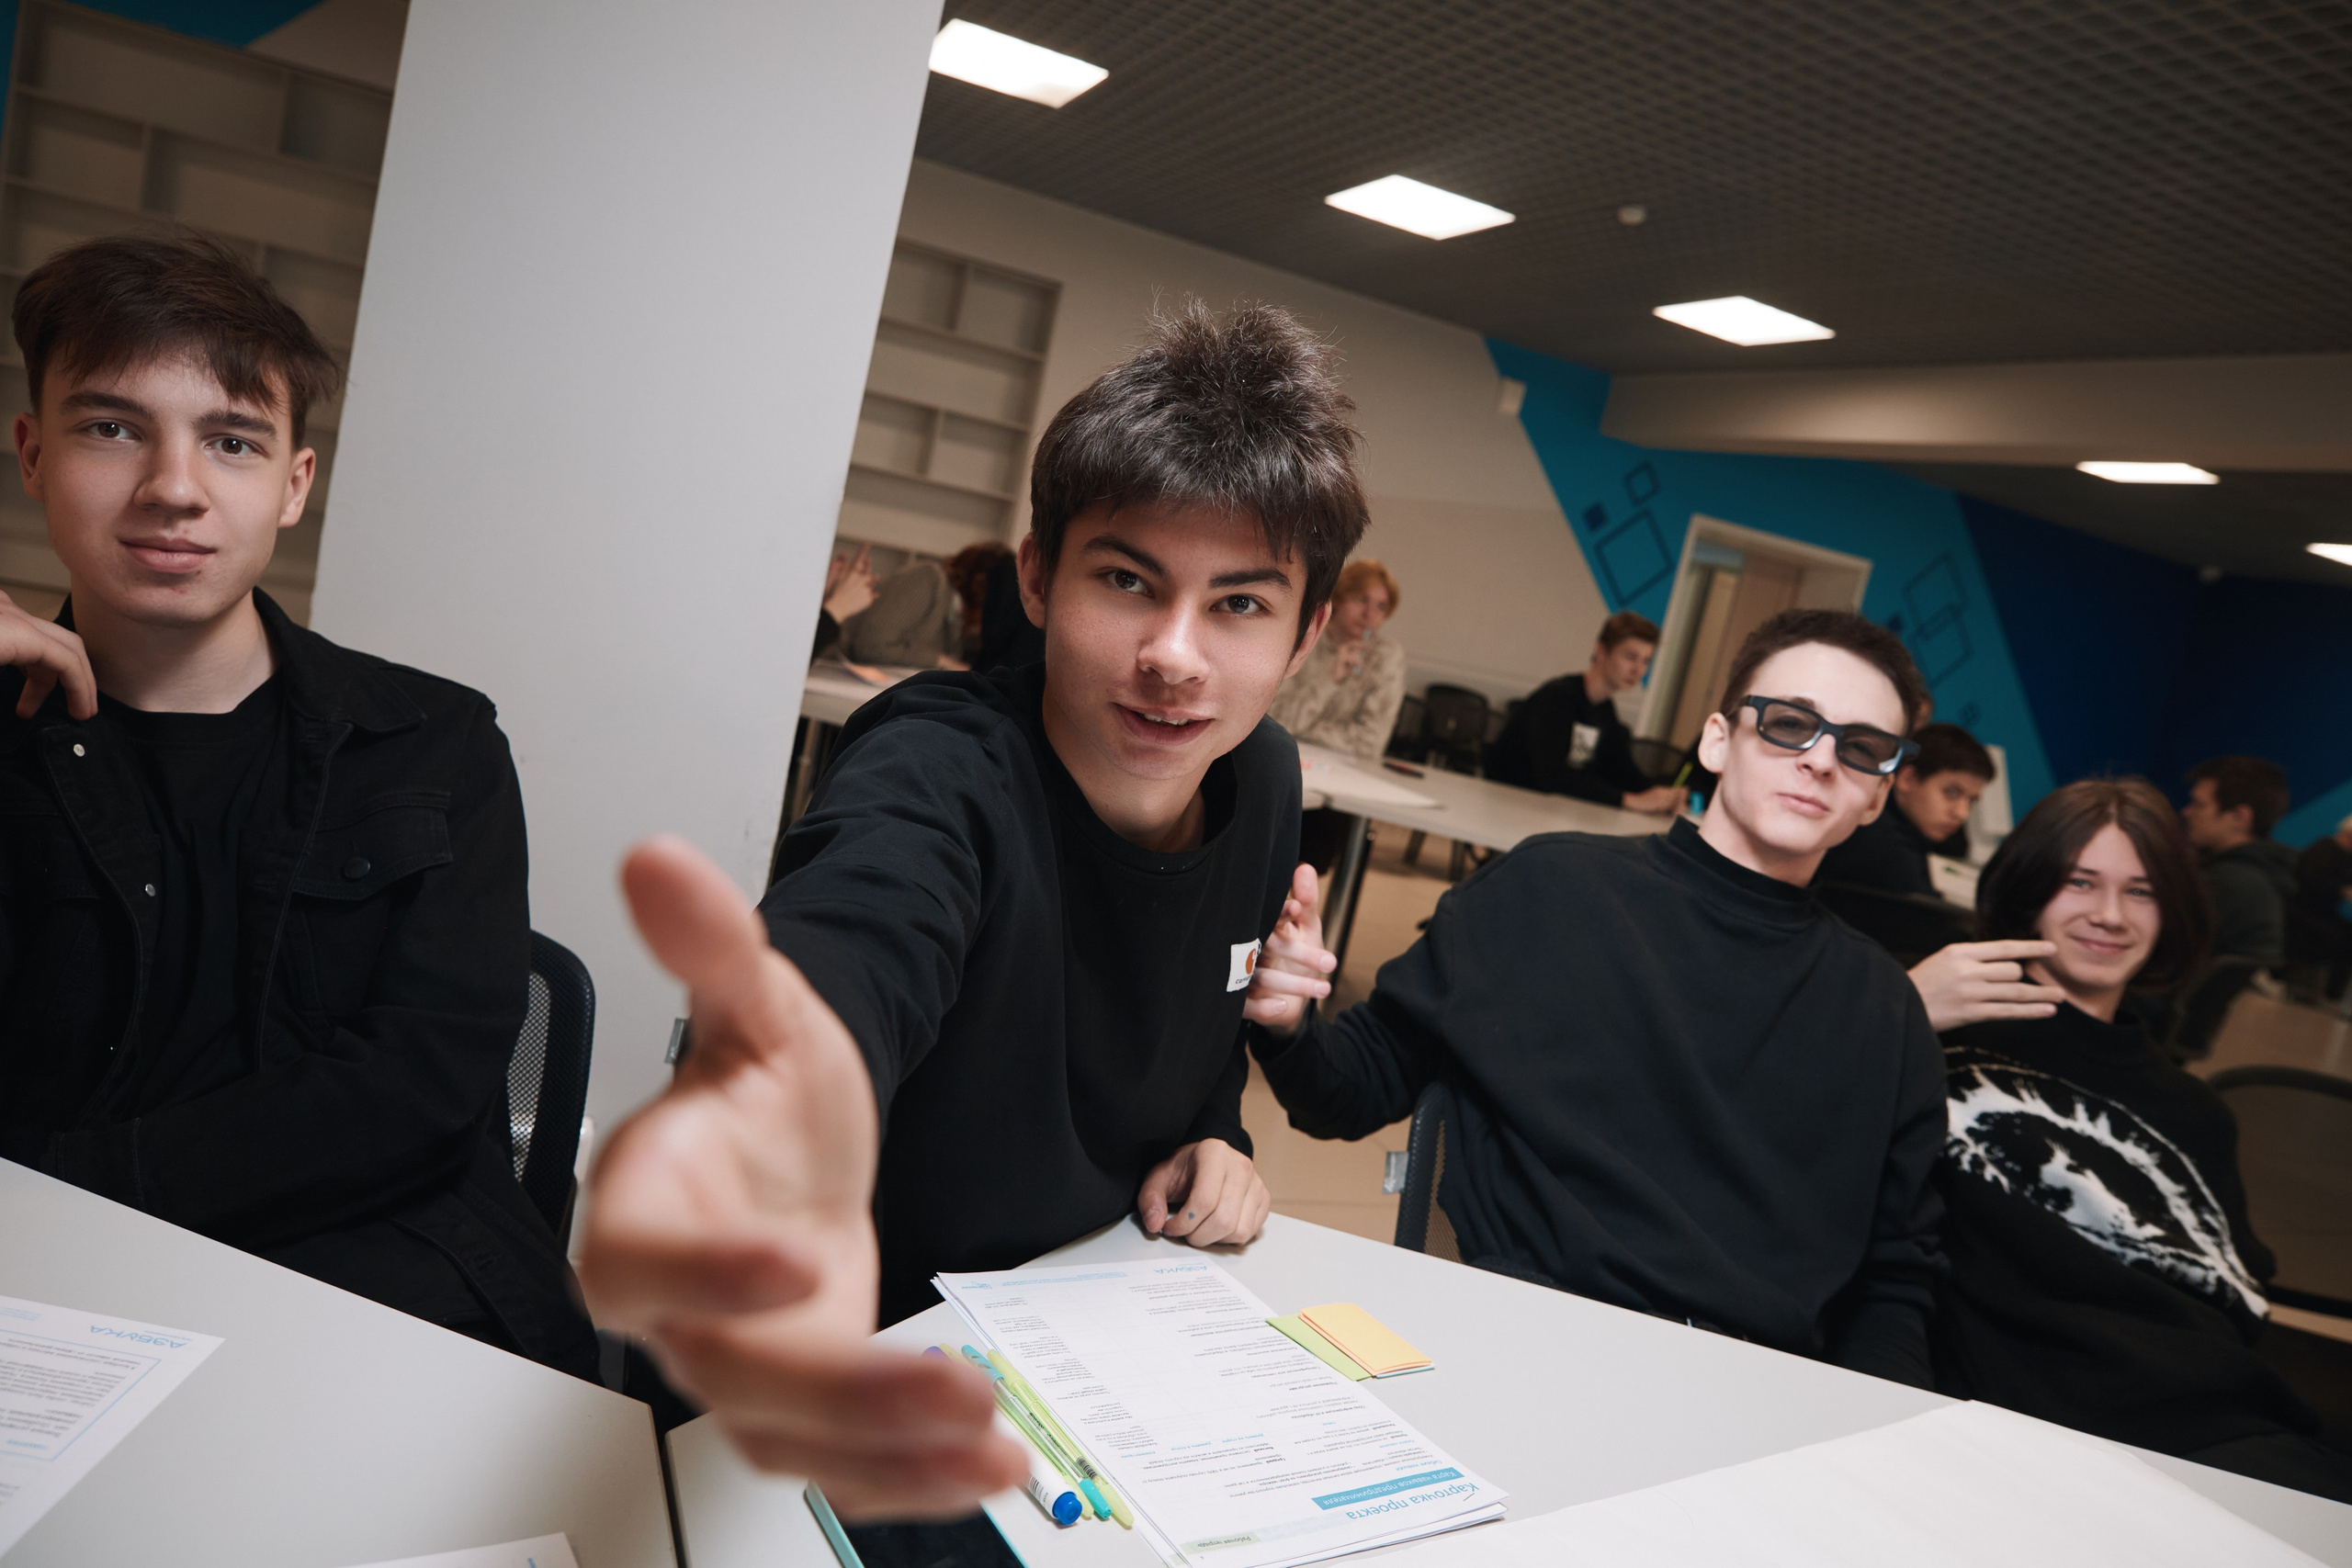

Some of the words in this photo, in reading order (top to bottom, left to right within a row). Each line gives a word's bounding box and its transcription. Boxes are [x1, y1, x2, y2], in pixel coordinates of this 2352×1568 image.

[89, 1324, 187, 1349] АЗБУКА
[1398, 1476, 1431, 1488] навыков
[1432, 1470, 1455, 1481] Карта
[1323, 1483, 1397, 1506] предпринимателя
[1409, 1483, 1479, 1506] Карточка
[1346, 1499, 1408, 1521] проекта
[1224, 1536, 1251, 1545] Рабочая
